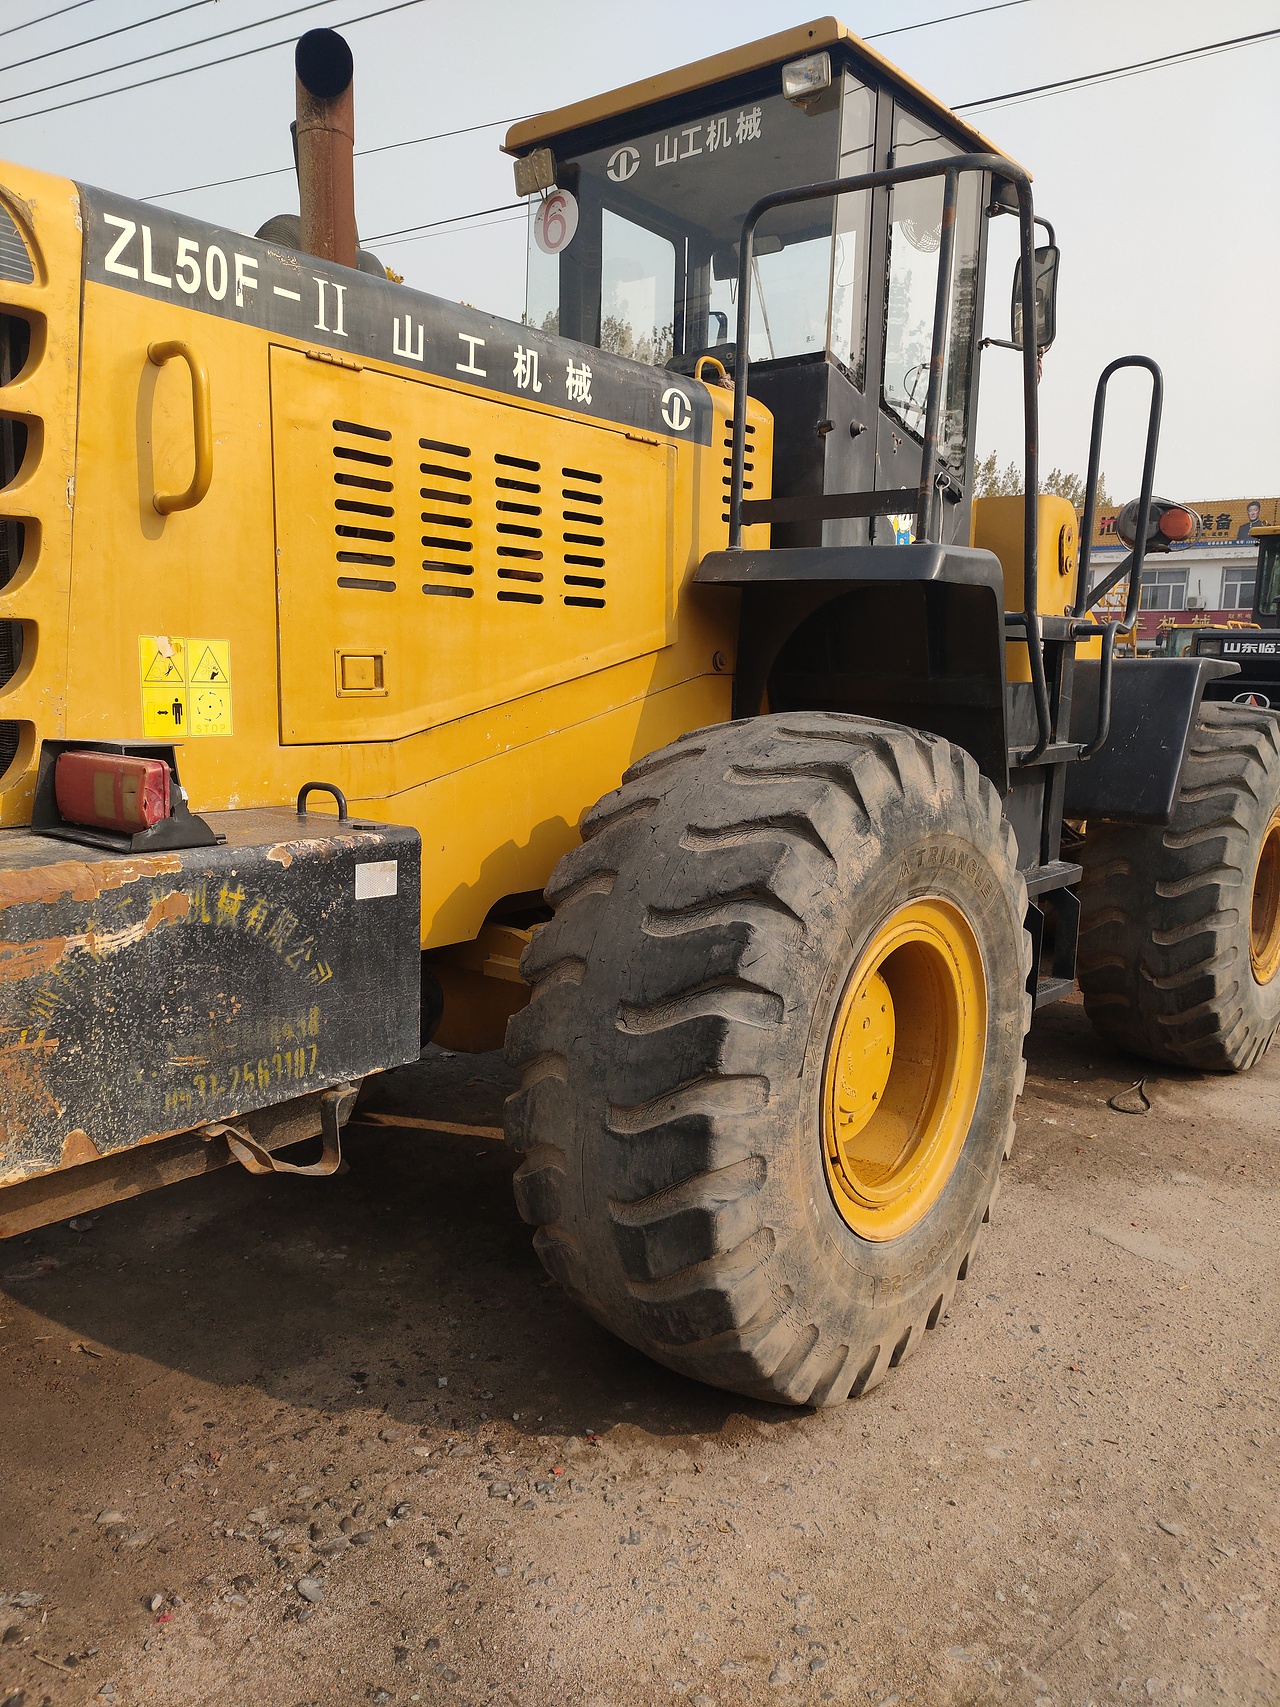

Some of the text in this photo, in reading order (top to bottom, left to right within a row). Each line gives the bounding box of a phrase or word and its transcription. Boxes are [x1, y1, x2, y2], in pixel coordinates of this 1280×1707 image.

[655, 106, 762, 167] 山工机械
[542, 195, 567, 249] 6
[392, 315, 593, 407] 山工机械
[196, 724, 226, 734] STOP
[915, 845, 993, 899] TRIANGLE
